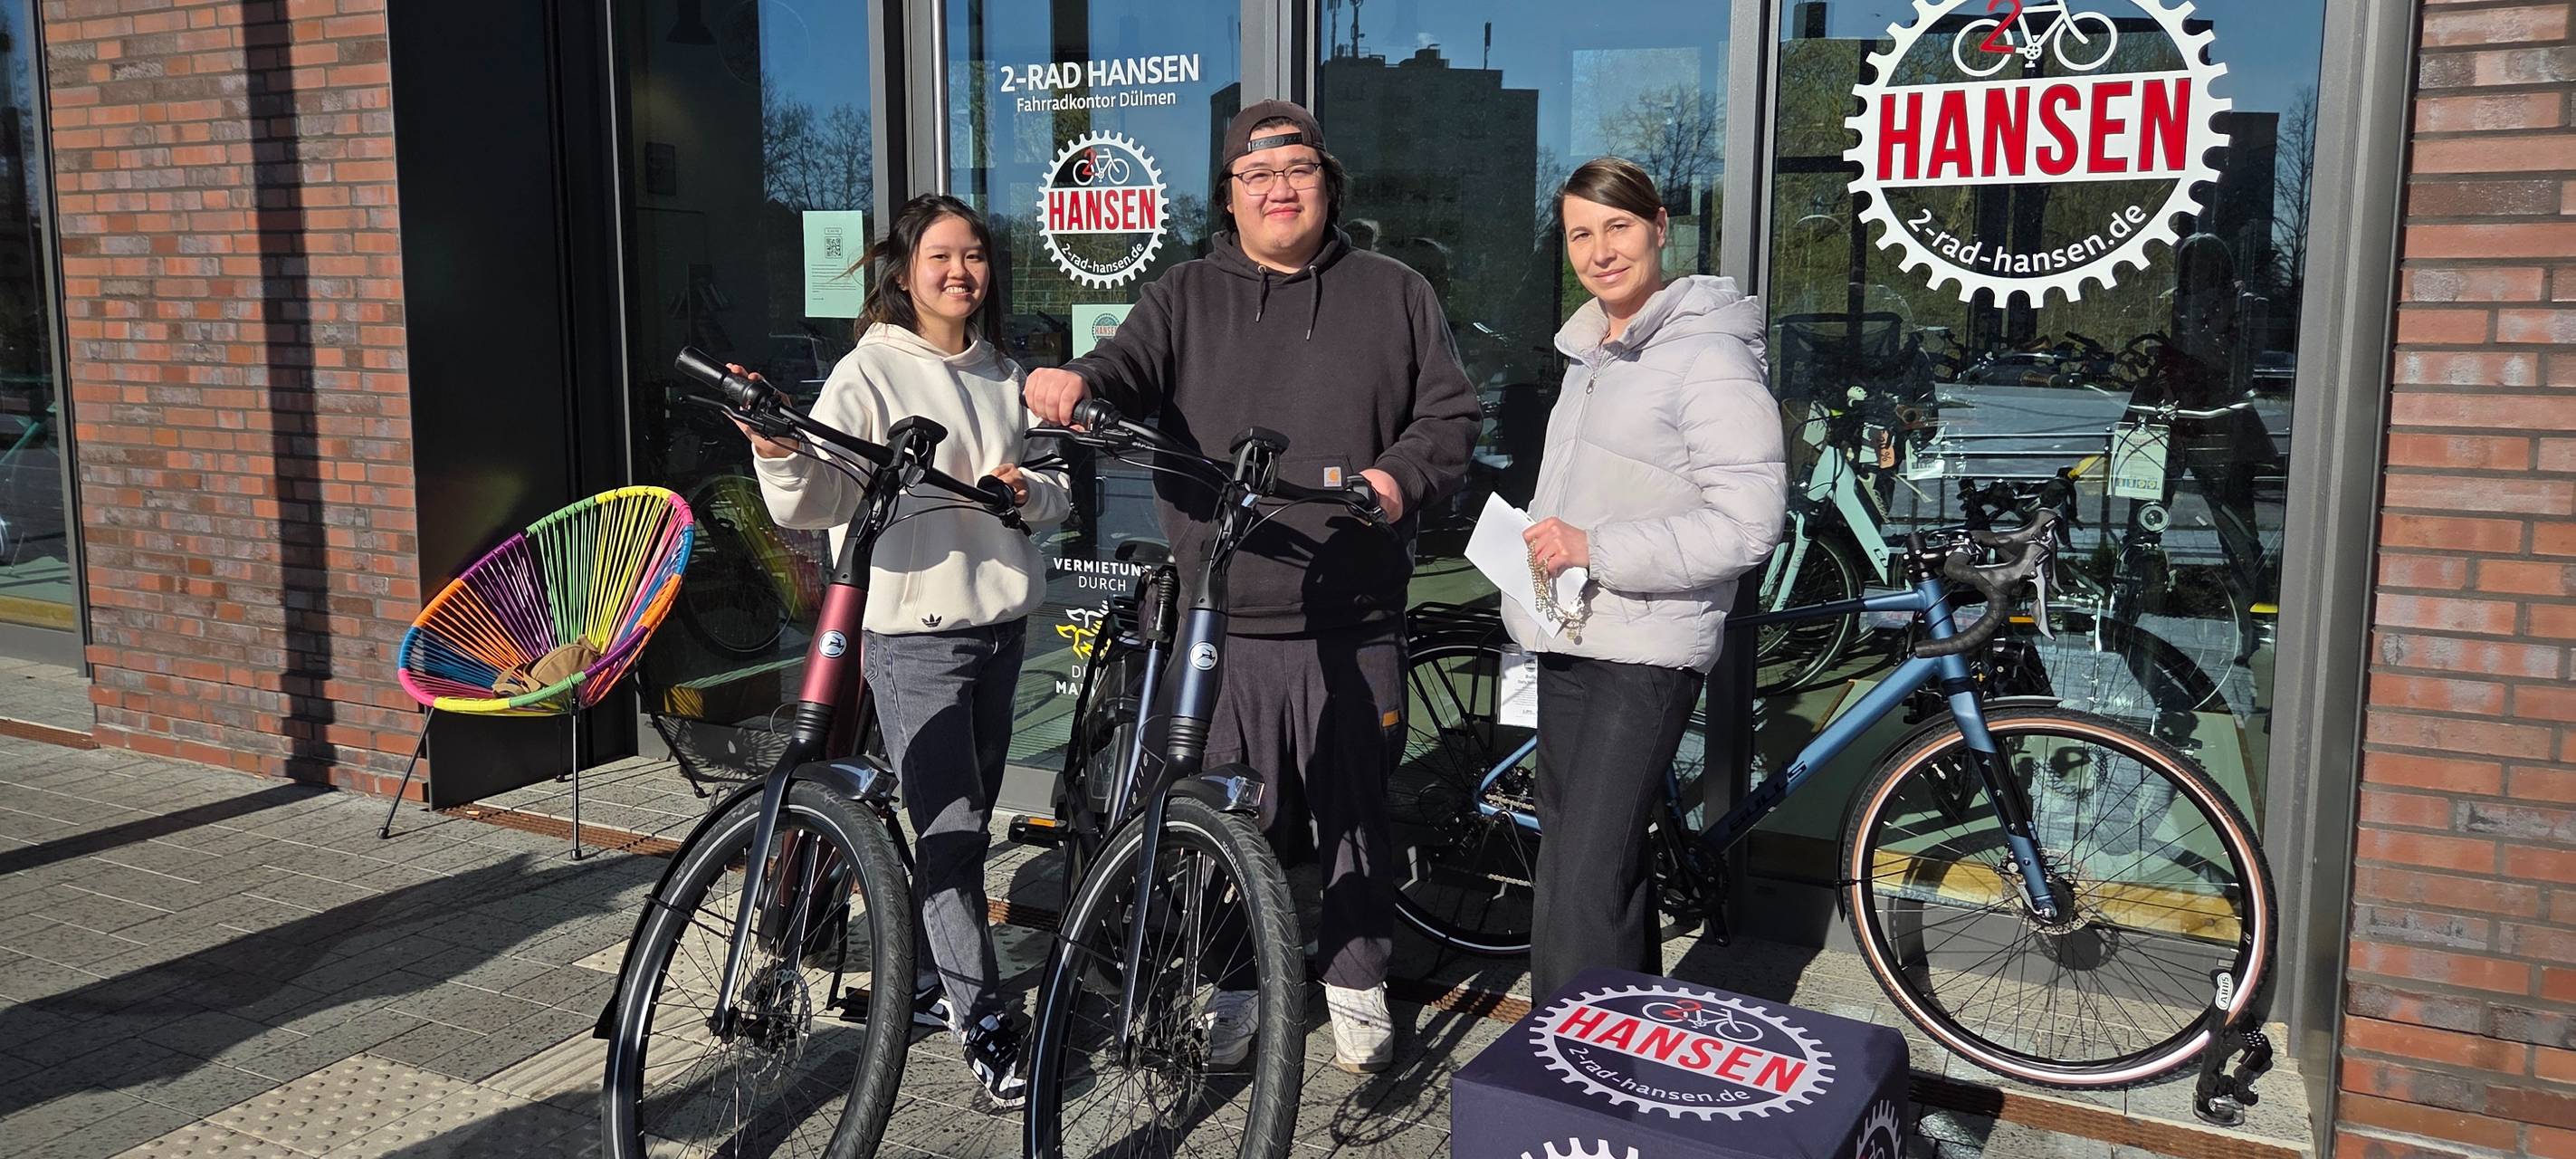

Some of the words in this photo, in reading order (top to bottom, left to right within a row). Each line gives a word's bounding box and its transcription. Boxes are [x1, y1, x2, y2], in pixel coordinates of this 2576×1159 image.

[1000, 62, 1082, 91] 2-RAD
[1087, 53, 1199, 87] HANSEN
[1016, 92, 1116, 112] Fahrradkontor
[1120, 90, 1176, 107] Dülmen
[1876, 78, 2191, 180] HANSEN
[1048, 188, 1156, 231] HANSEN
[1061, 243, 1144, 273] 2-rad-hansen.de
[1907, 205, 2146, 273] 2-rad-hansen.de
[1078, 576, 1126, 591] DURCH
[1554, 1006, 1808, 1094] HANSEN
[1569, 1048, 1751, 1102] 2-rad-hansen.de
